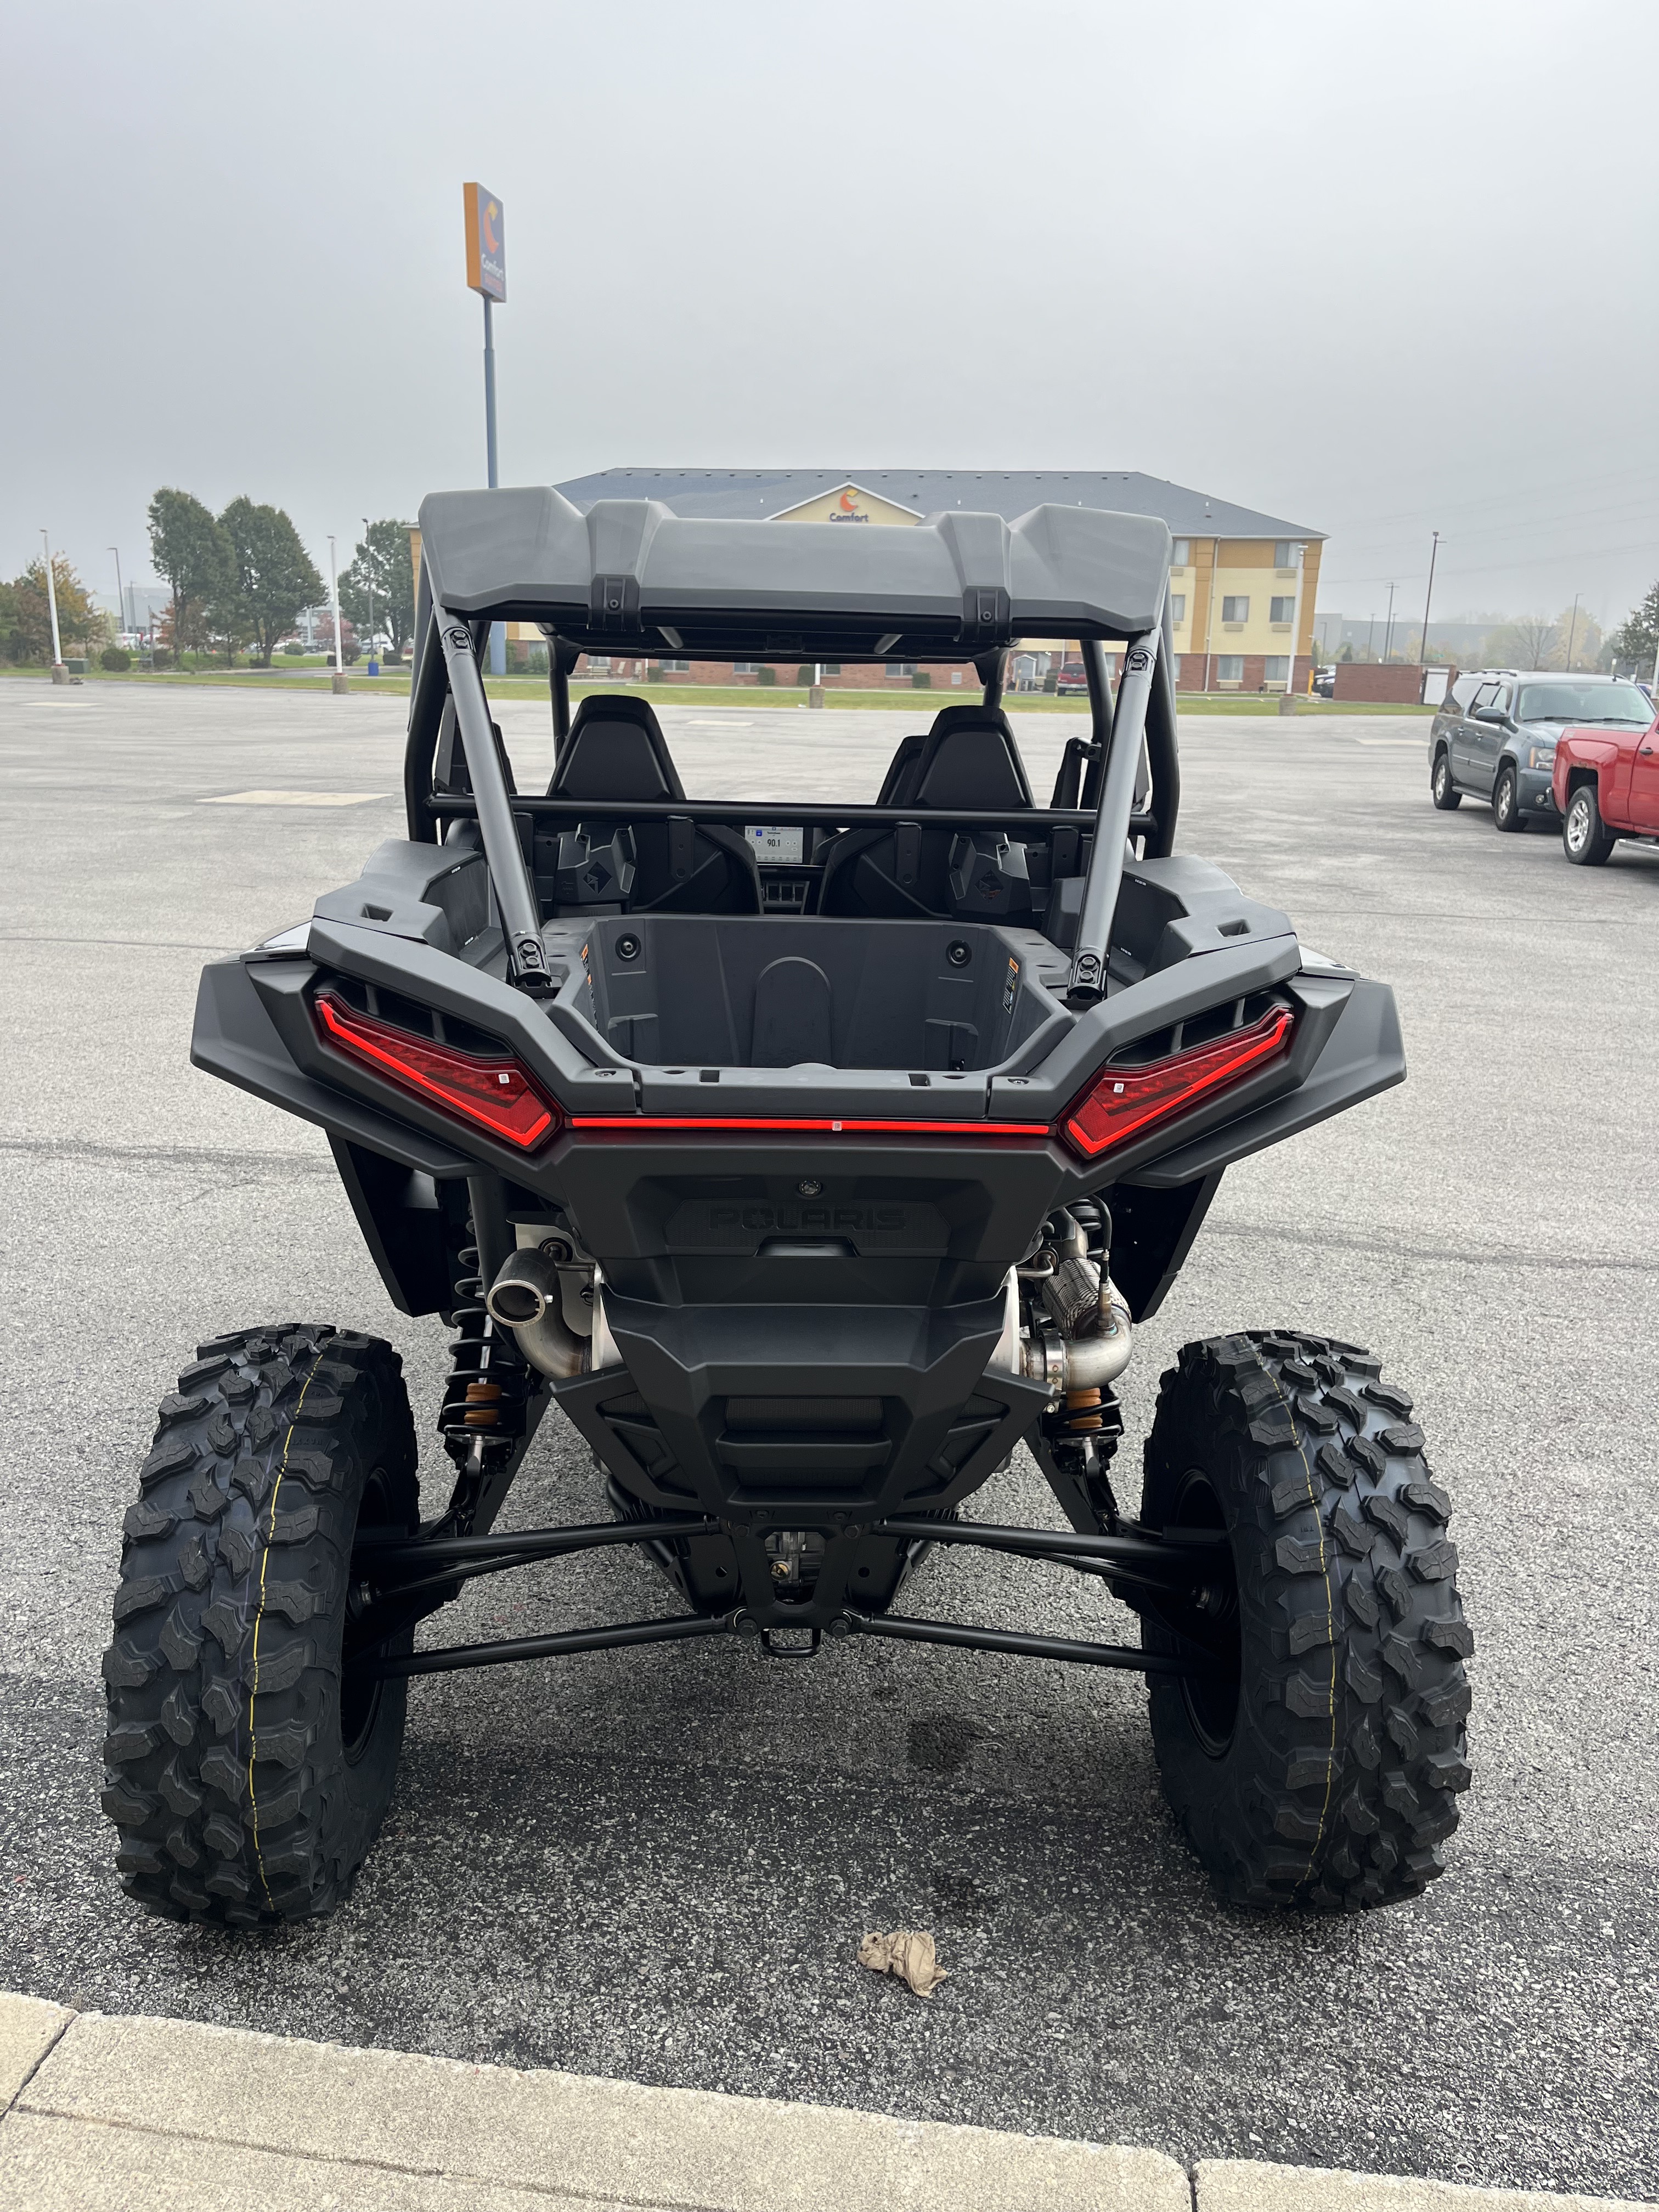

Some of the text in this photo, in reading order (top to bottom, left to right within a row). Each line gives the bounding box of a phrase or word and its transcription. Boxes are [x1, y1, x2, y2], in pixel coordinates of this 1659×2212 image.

[830, 512, 868, 522] Comfort
[767, 839, 780, 847] 90.1
[709, 1207, 905, 1230] POLARIS
